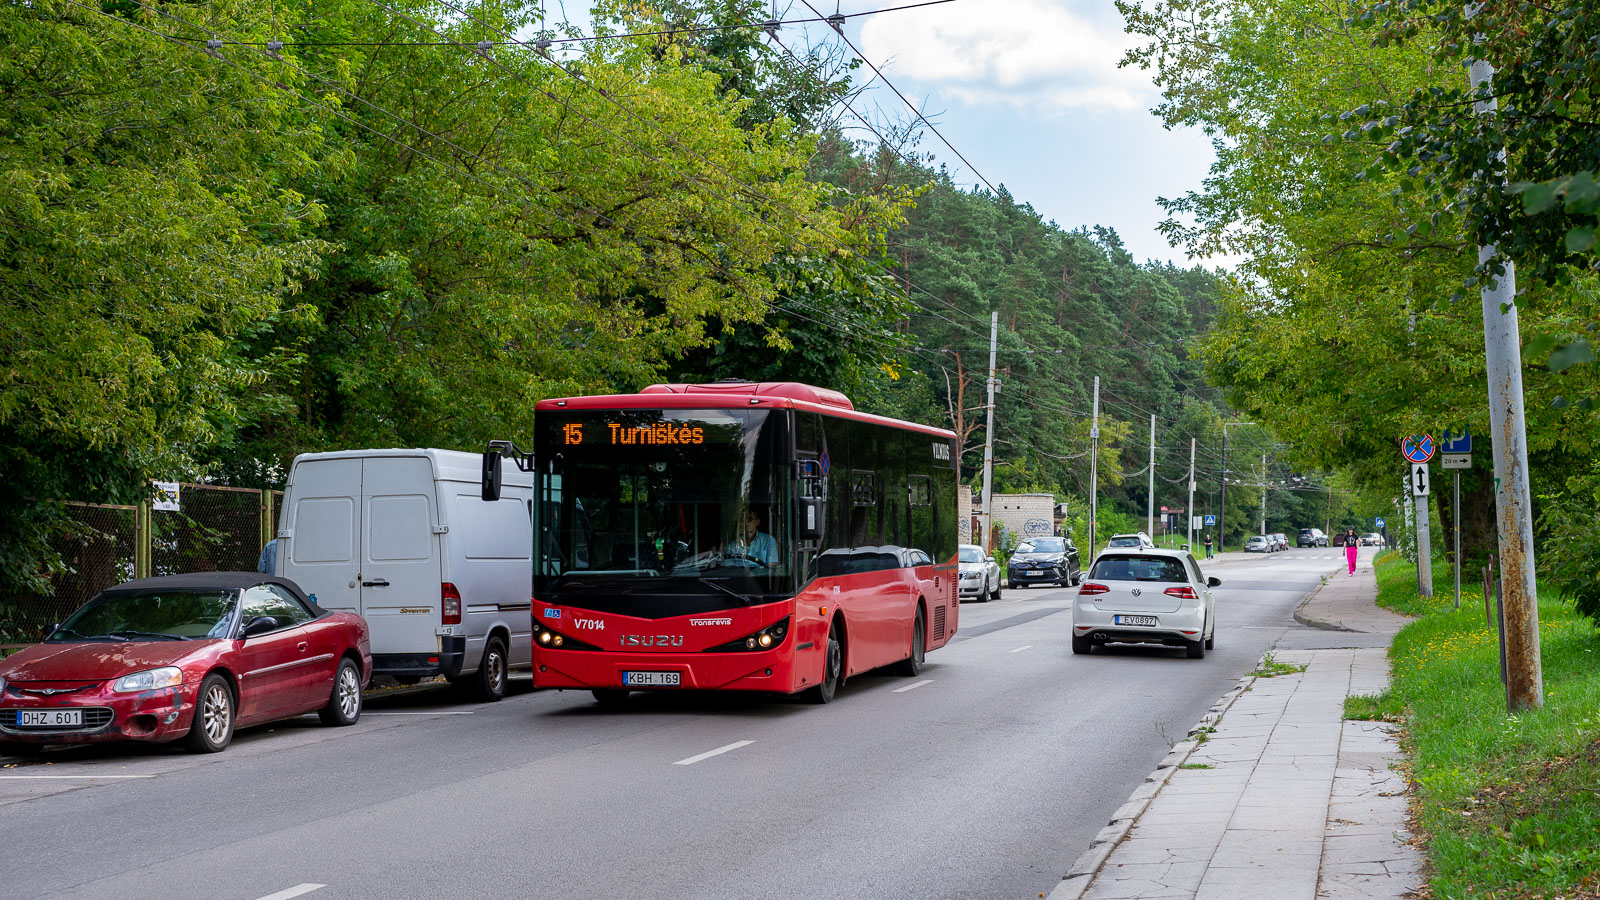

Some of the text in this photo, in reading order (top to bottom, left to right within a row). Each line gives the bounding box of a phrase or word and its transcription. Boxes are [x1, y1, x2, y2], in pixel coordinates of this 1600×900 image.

[563, 423, 704, 445] 15 Turniškės
[574, 619, 605, 630] V7014
[1124, 616, 1154, 625] EV0897
[620, 634, 684, 647] ISUZU
[629, 673, 679, 684] KBH 169
[23, 712, 79, 724] DHZ 601
